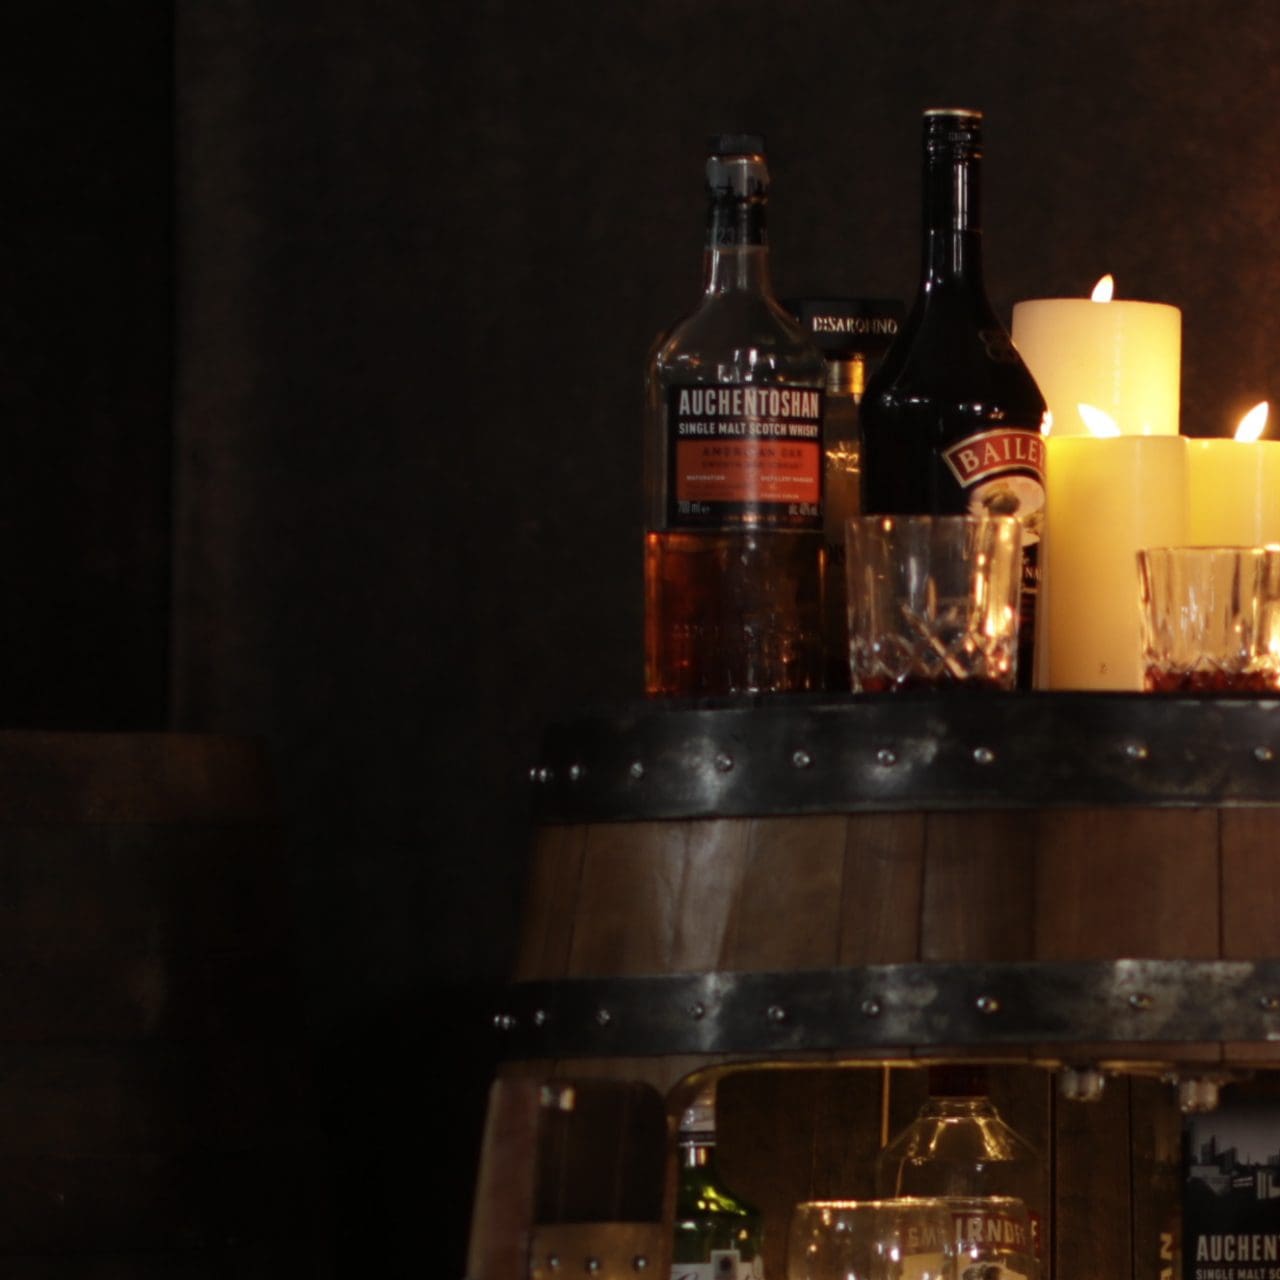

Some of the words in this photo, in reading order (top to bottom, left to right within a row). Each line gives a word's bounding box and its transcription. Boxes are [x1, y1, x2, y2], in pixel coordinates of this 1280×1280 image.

[679, 388, 819, 418] AUCHENTOSHAN
[679, 422, 715, 435] SINGLE
[718, 423, 746, 435] MALT
[750, 423, 787, 436] SCOTCH
[788, 424, 818, 438] WHISKY
[1196, 1268, 1234, 1280] SINGLE
[1237, 1268, 1265, 1280] MALT
